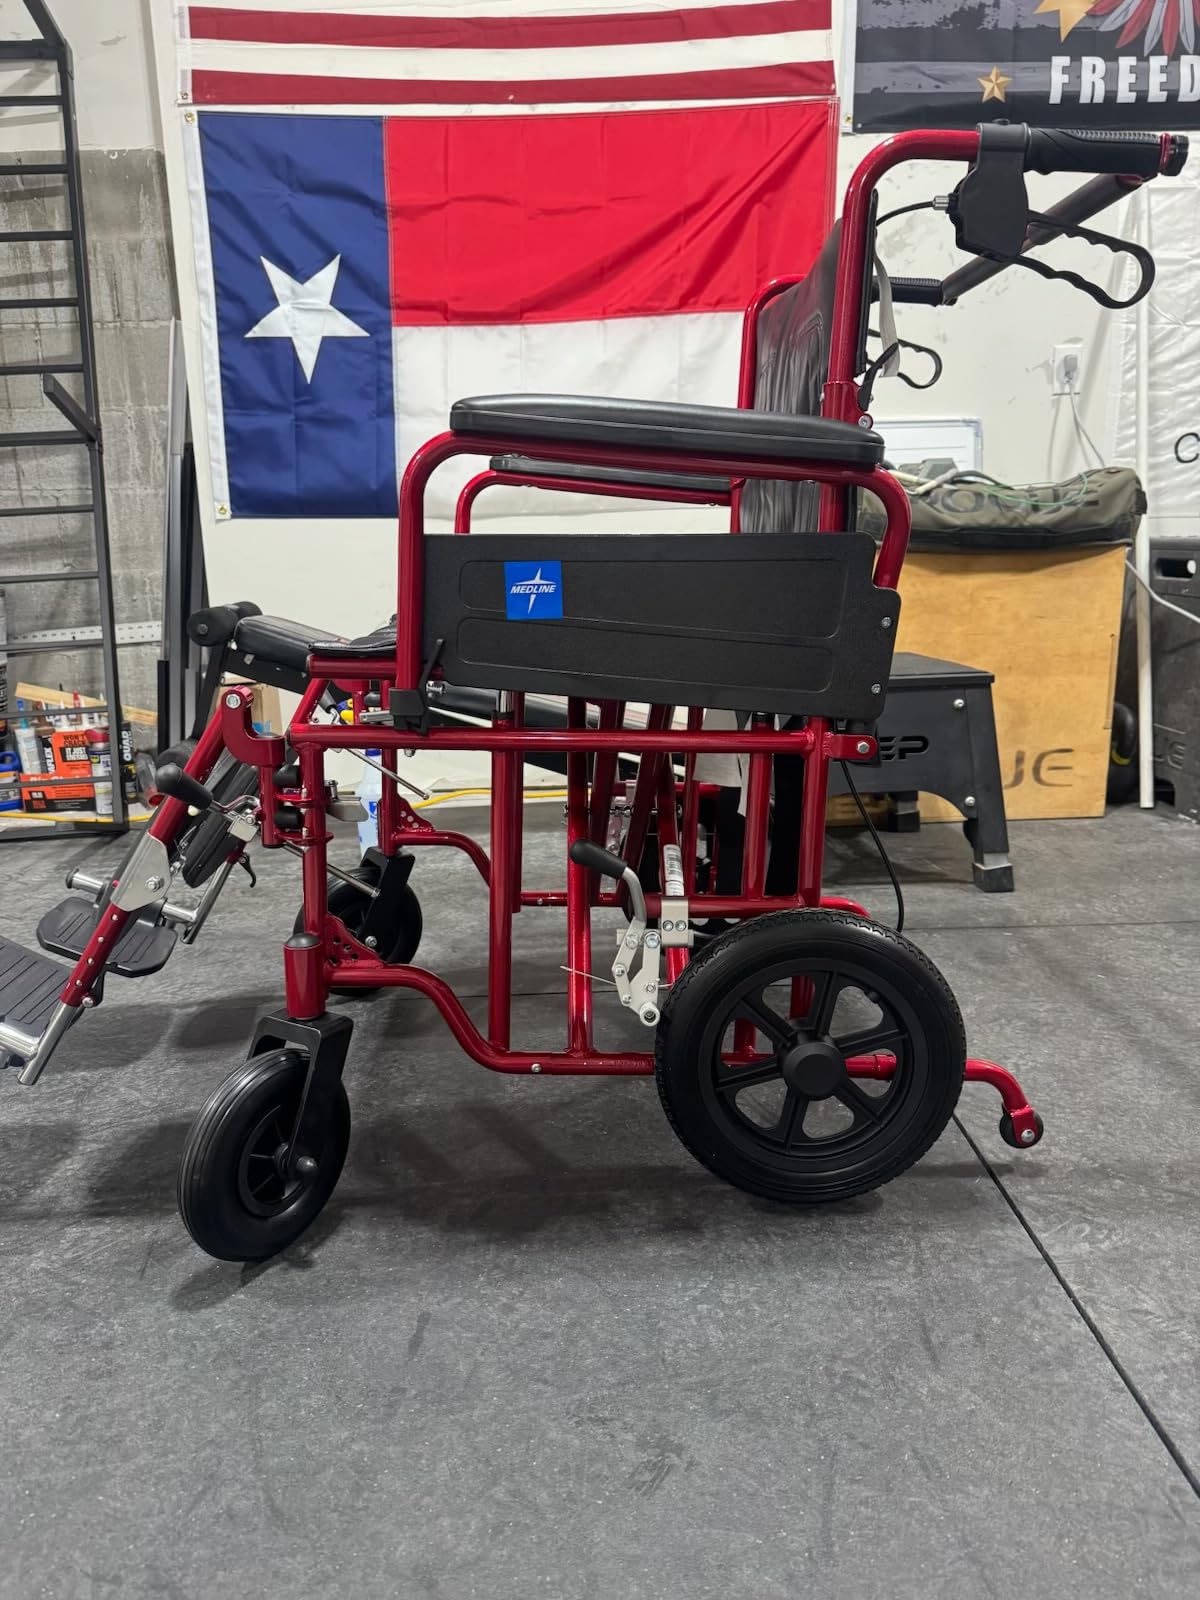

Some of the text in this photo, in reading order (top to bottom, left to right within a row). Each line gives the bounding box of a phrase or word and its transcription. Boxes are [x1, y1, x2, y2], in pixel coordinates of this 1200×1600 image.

[1049, 55, 1200, 104] FREED
[510, 584, 557, 594] MEDLINE
[121, 731, 132, 761] QUAD
